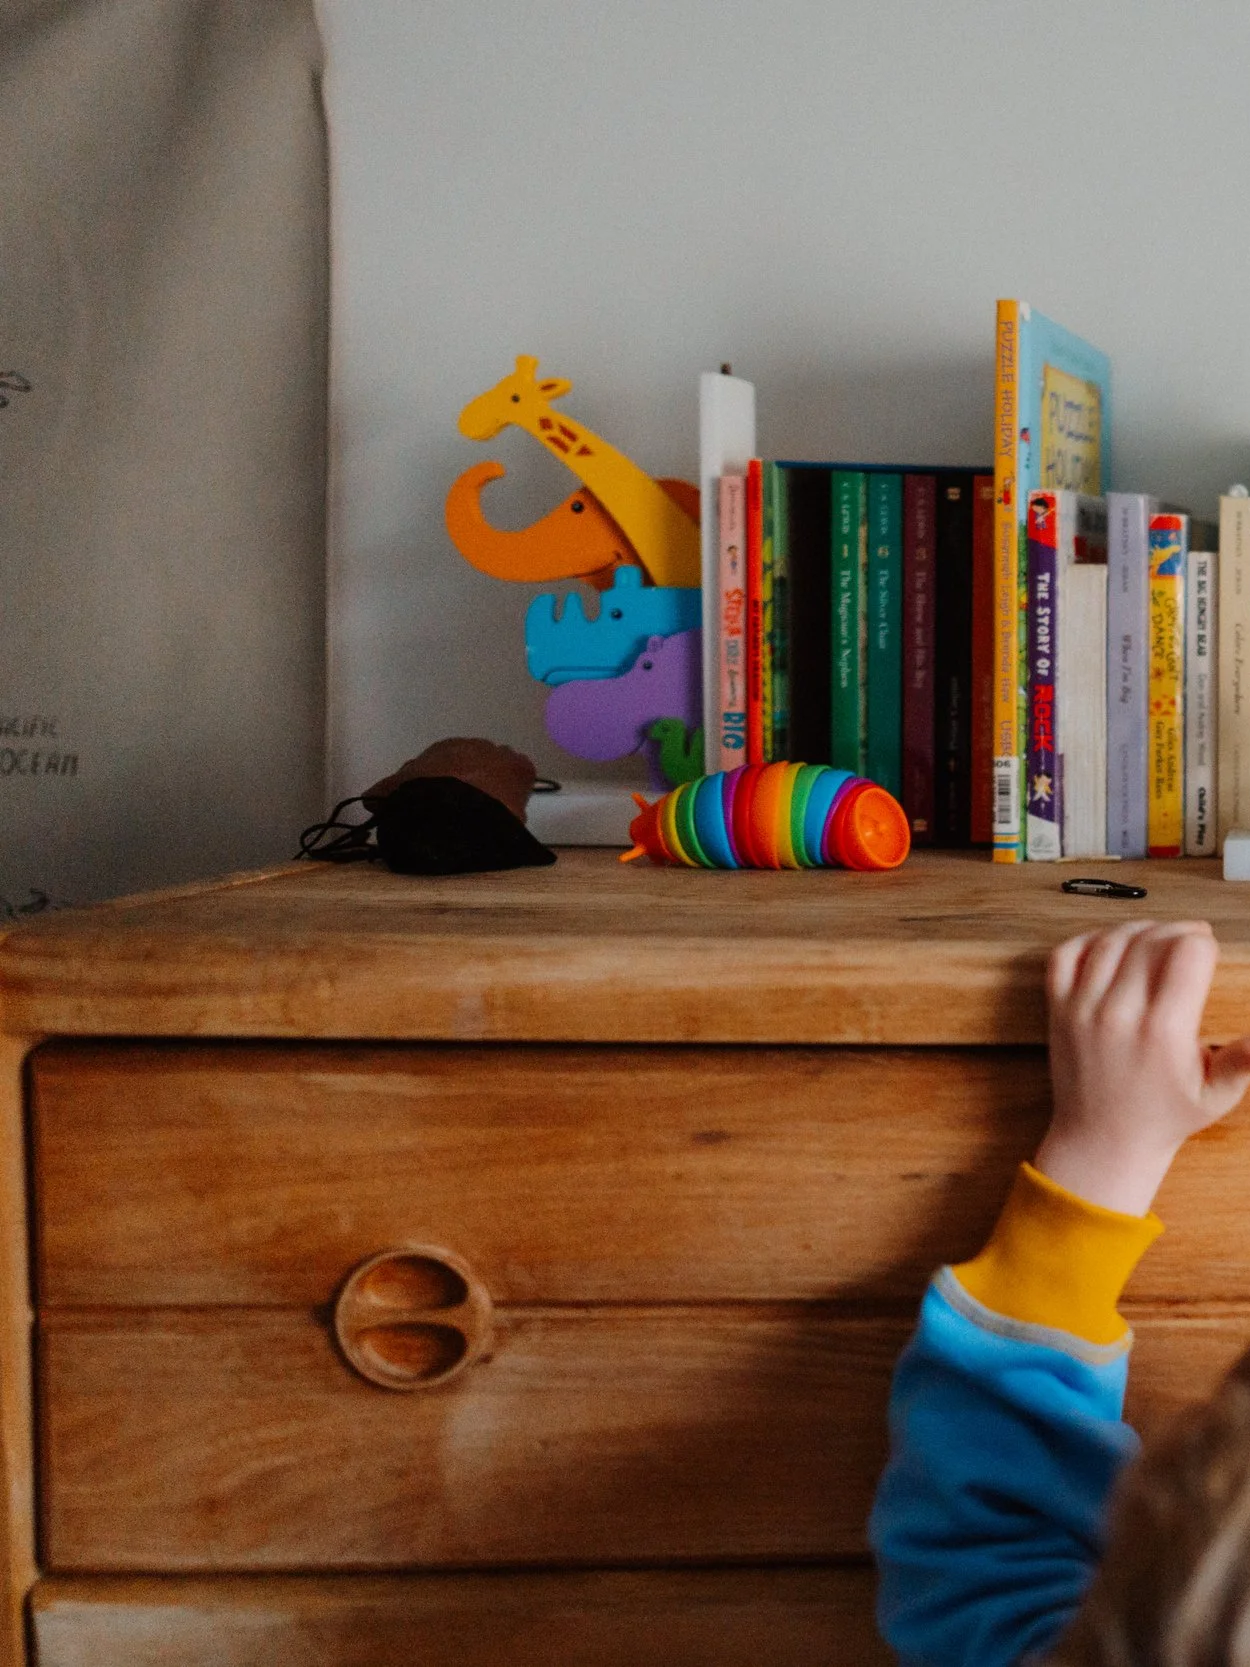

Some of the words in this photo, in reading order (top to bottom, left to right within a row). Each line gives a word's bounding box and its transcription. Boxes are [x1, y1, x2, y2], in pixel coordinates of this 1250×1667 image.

[1000, 320, 1014, 384] PUZZLE
[1000, 389, 1014, 459] HOLIDAY
[1196, 560, 1208, 577] THE
[1036, 571, 1052, 599] THE
[1196, 579, 1208, 595] BIG
[1036, 606, 1054, 654] STORY
[1151, 613, 1166, 660] DANCE
[1196, 633, 1208, 657] BEAR
[1036, 658, 1053, 678] OF
[722, 711, 747, 750] BIG
[1033, 684, 1055, 753] ROCK
[0, 747, 79, 776] OCEAN
[1197, 786, 1209, 821] Child's
[1195, 823, 1207, 846] Play
